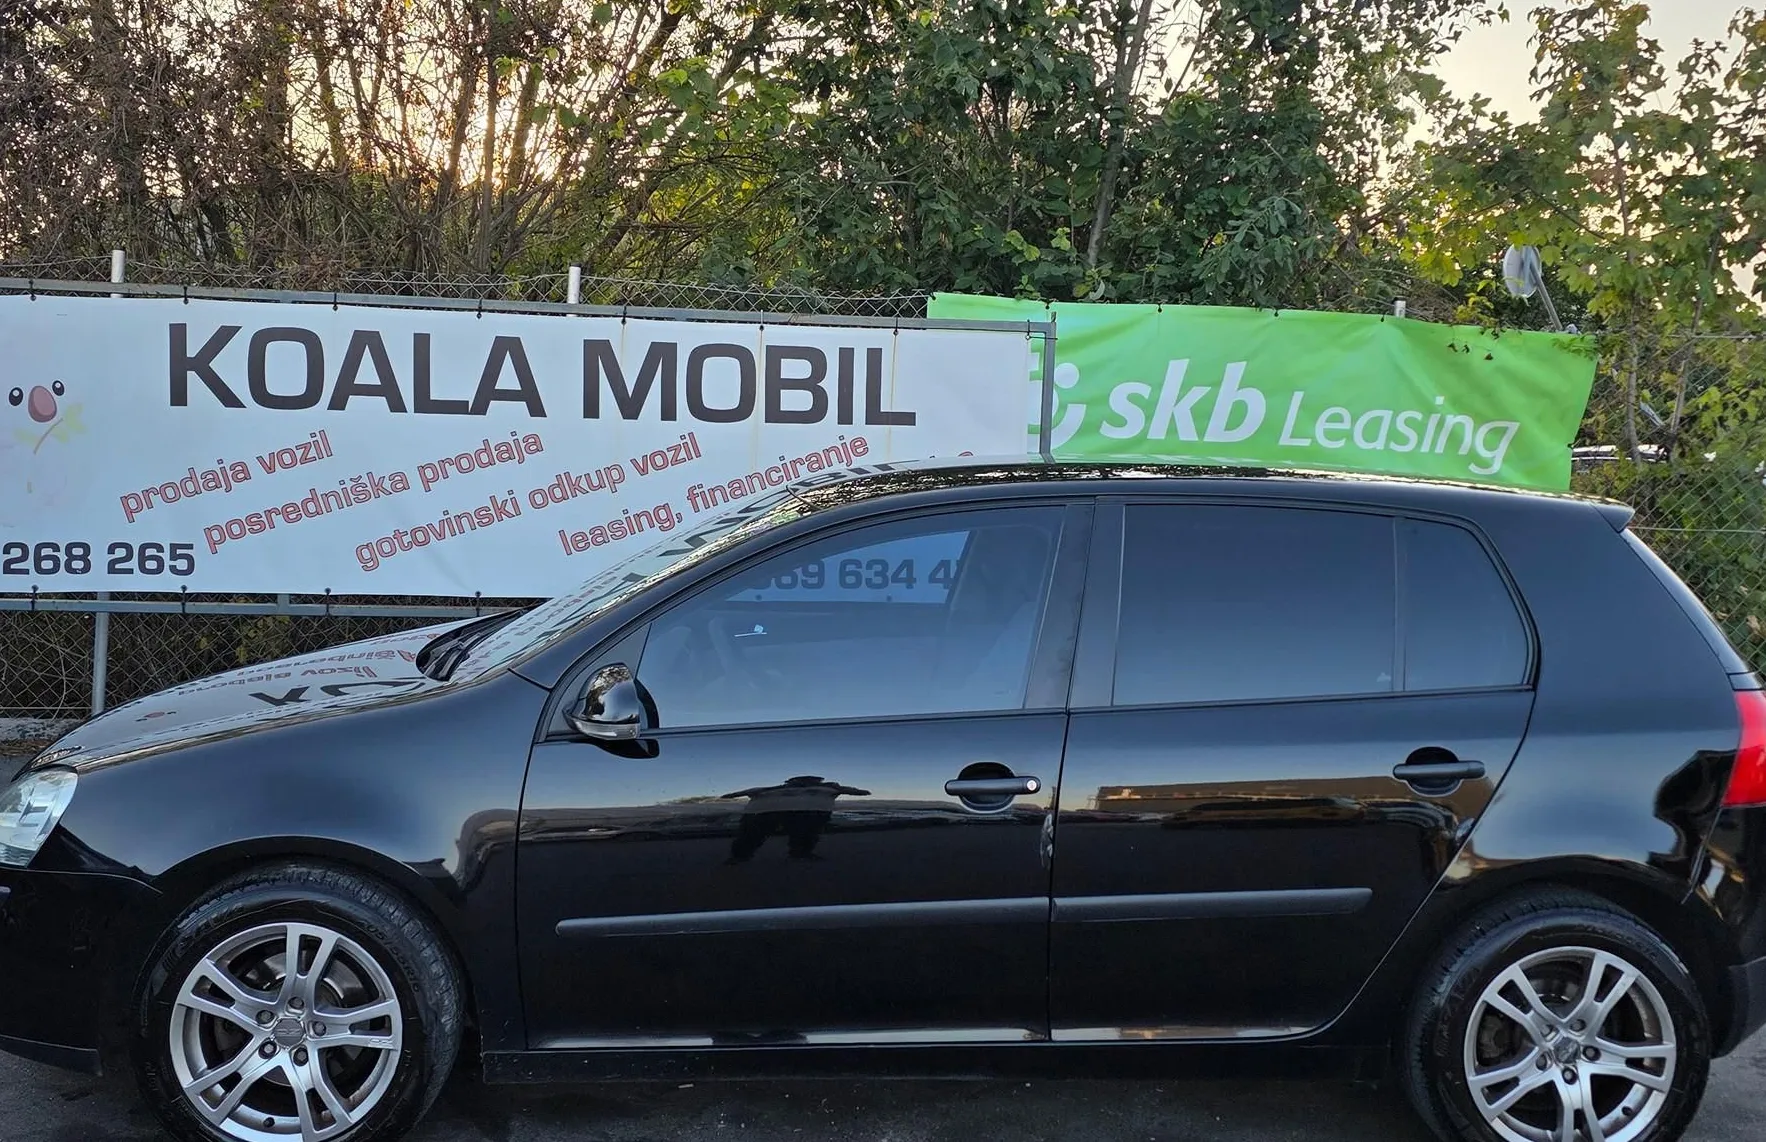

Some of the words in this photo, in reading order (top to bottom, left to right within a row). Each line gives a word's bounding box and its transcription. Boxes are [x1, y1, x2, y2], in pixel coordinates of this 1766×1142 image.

[169, 322, 547, 418] KOALA
[583, 338, 916, 427] MOBIL
[1099, 358, 1267, 443] skb
[1279, 391, 1520, 475] Leasing
[120, 458, 252, 523] prodaja
[256, 430, 333, 476] vozil
[203, 467, 410, 555] posredniška
[417, 430, 544, 492] prodaja
[354, 490, 521, 572] gotovinski
[528, 462, 626, 511] odkup
[630, 432, 702, 476] vozil
[558, 502, 683, 556] leasing,
[687, 434, 870, 514] financiranje
[3, 541, 91, 575] 268
[107, 542, 195, 576] 265
[838, 558, 917, 590] 634
